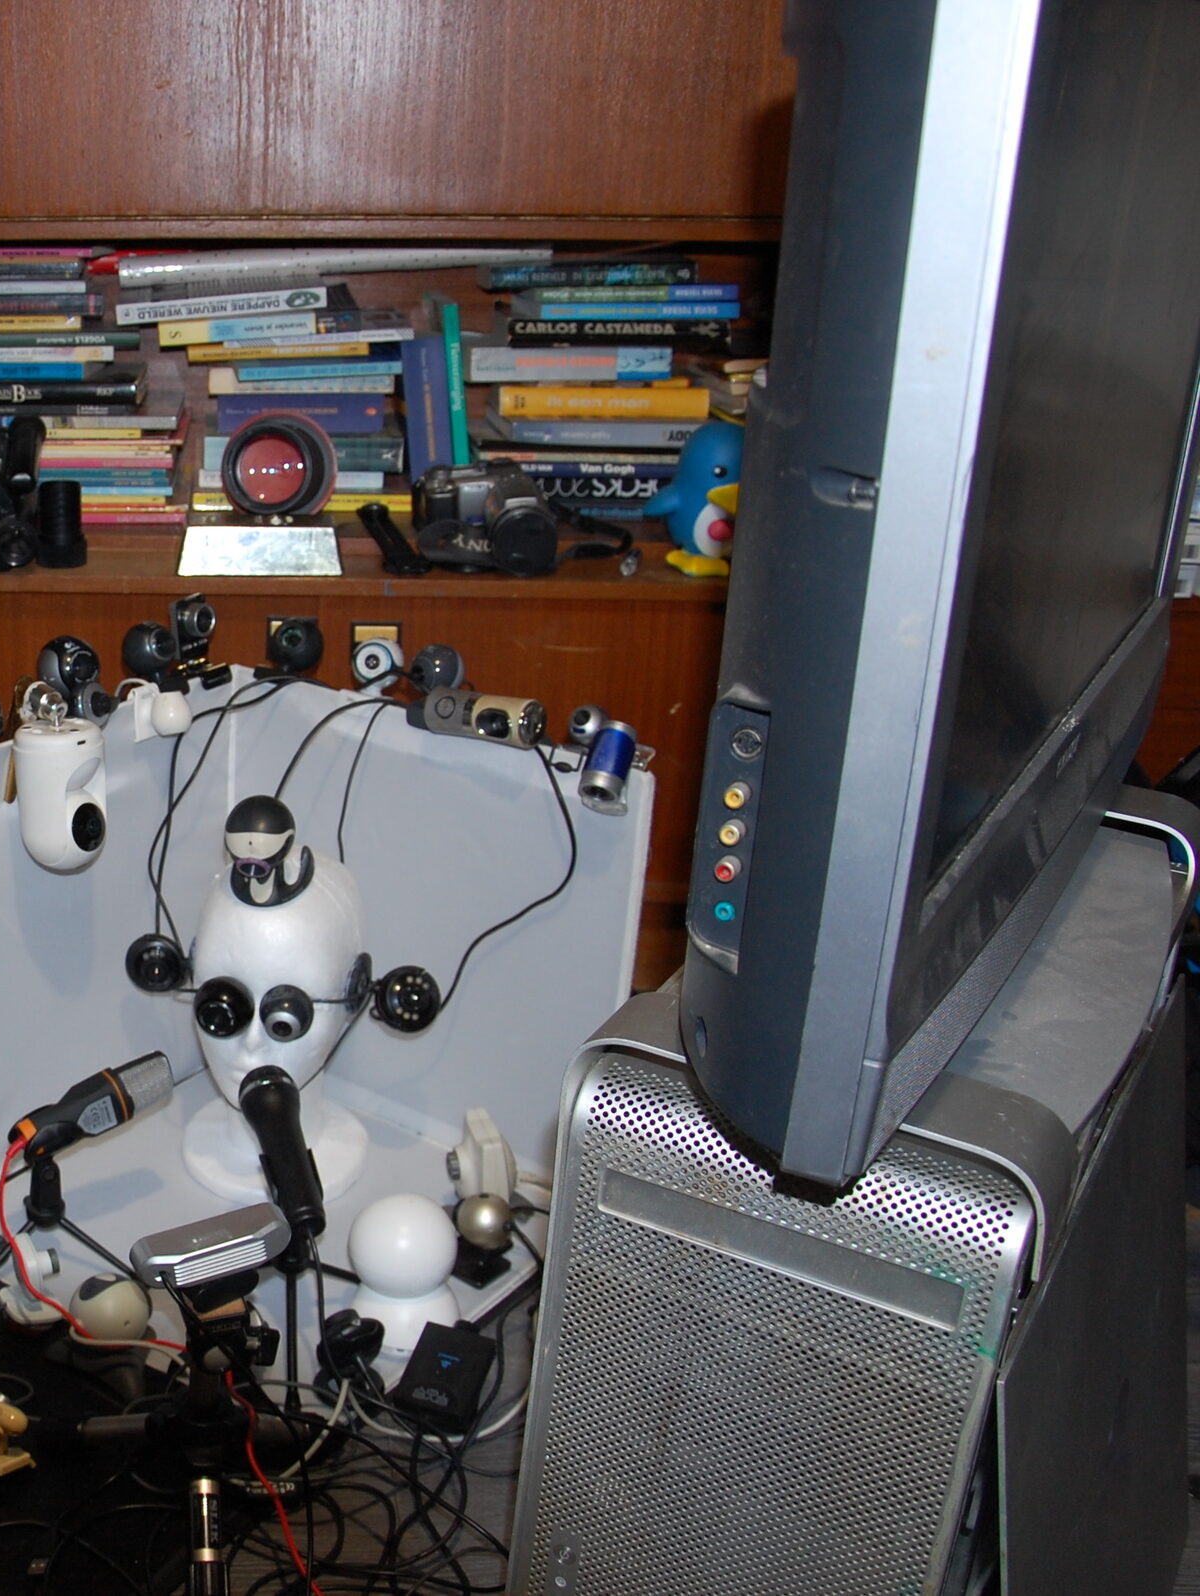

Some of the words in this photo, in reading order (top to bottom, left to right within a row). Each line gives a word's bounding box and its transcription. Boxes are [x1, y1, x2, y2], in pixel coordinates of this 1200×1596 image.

[184, 303, 230, 316] NIEUWE
[233, 299, 281, 312] DAPPERE
[138, 306, 182, 320] WERELD
[234, 325, 265, 334] leven
[275, 321, 308, 333] Verander
[515, 322, 577, 335] CARLOS
[583, 323, 676, 335] CASTANEDA
[75, 334, 106, 344] VOGELS
[12, 384, 42, 403] BOOK
[579, 462, 602, 473] Van
[604, 463, 636, 475] Gogh
[208, 1499, 220, 1543] SLIK
